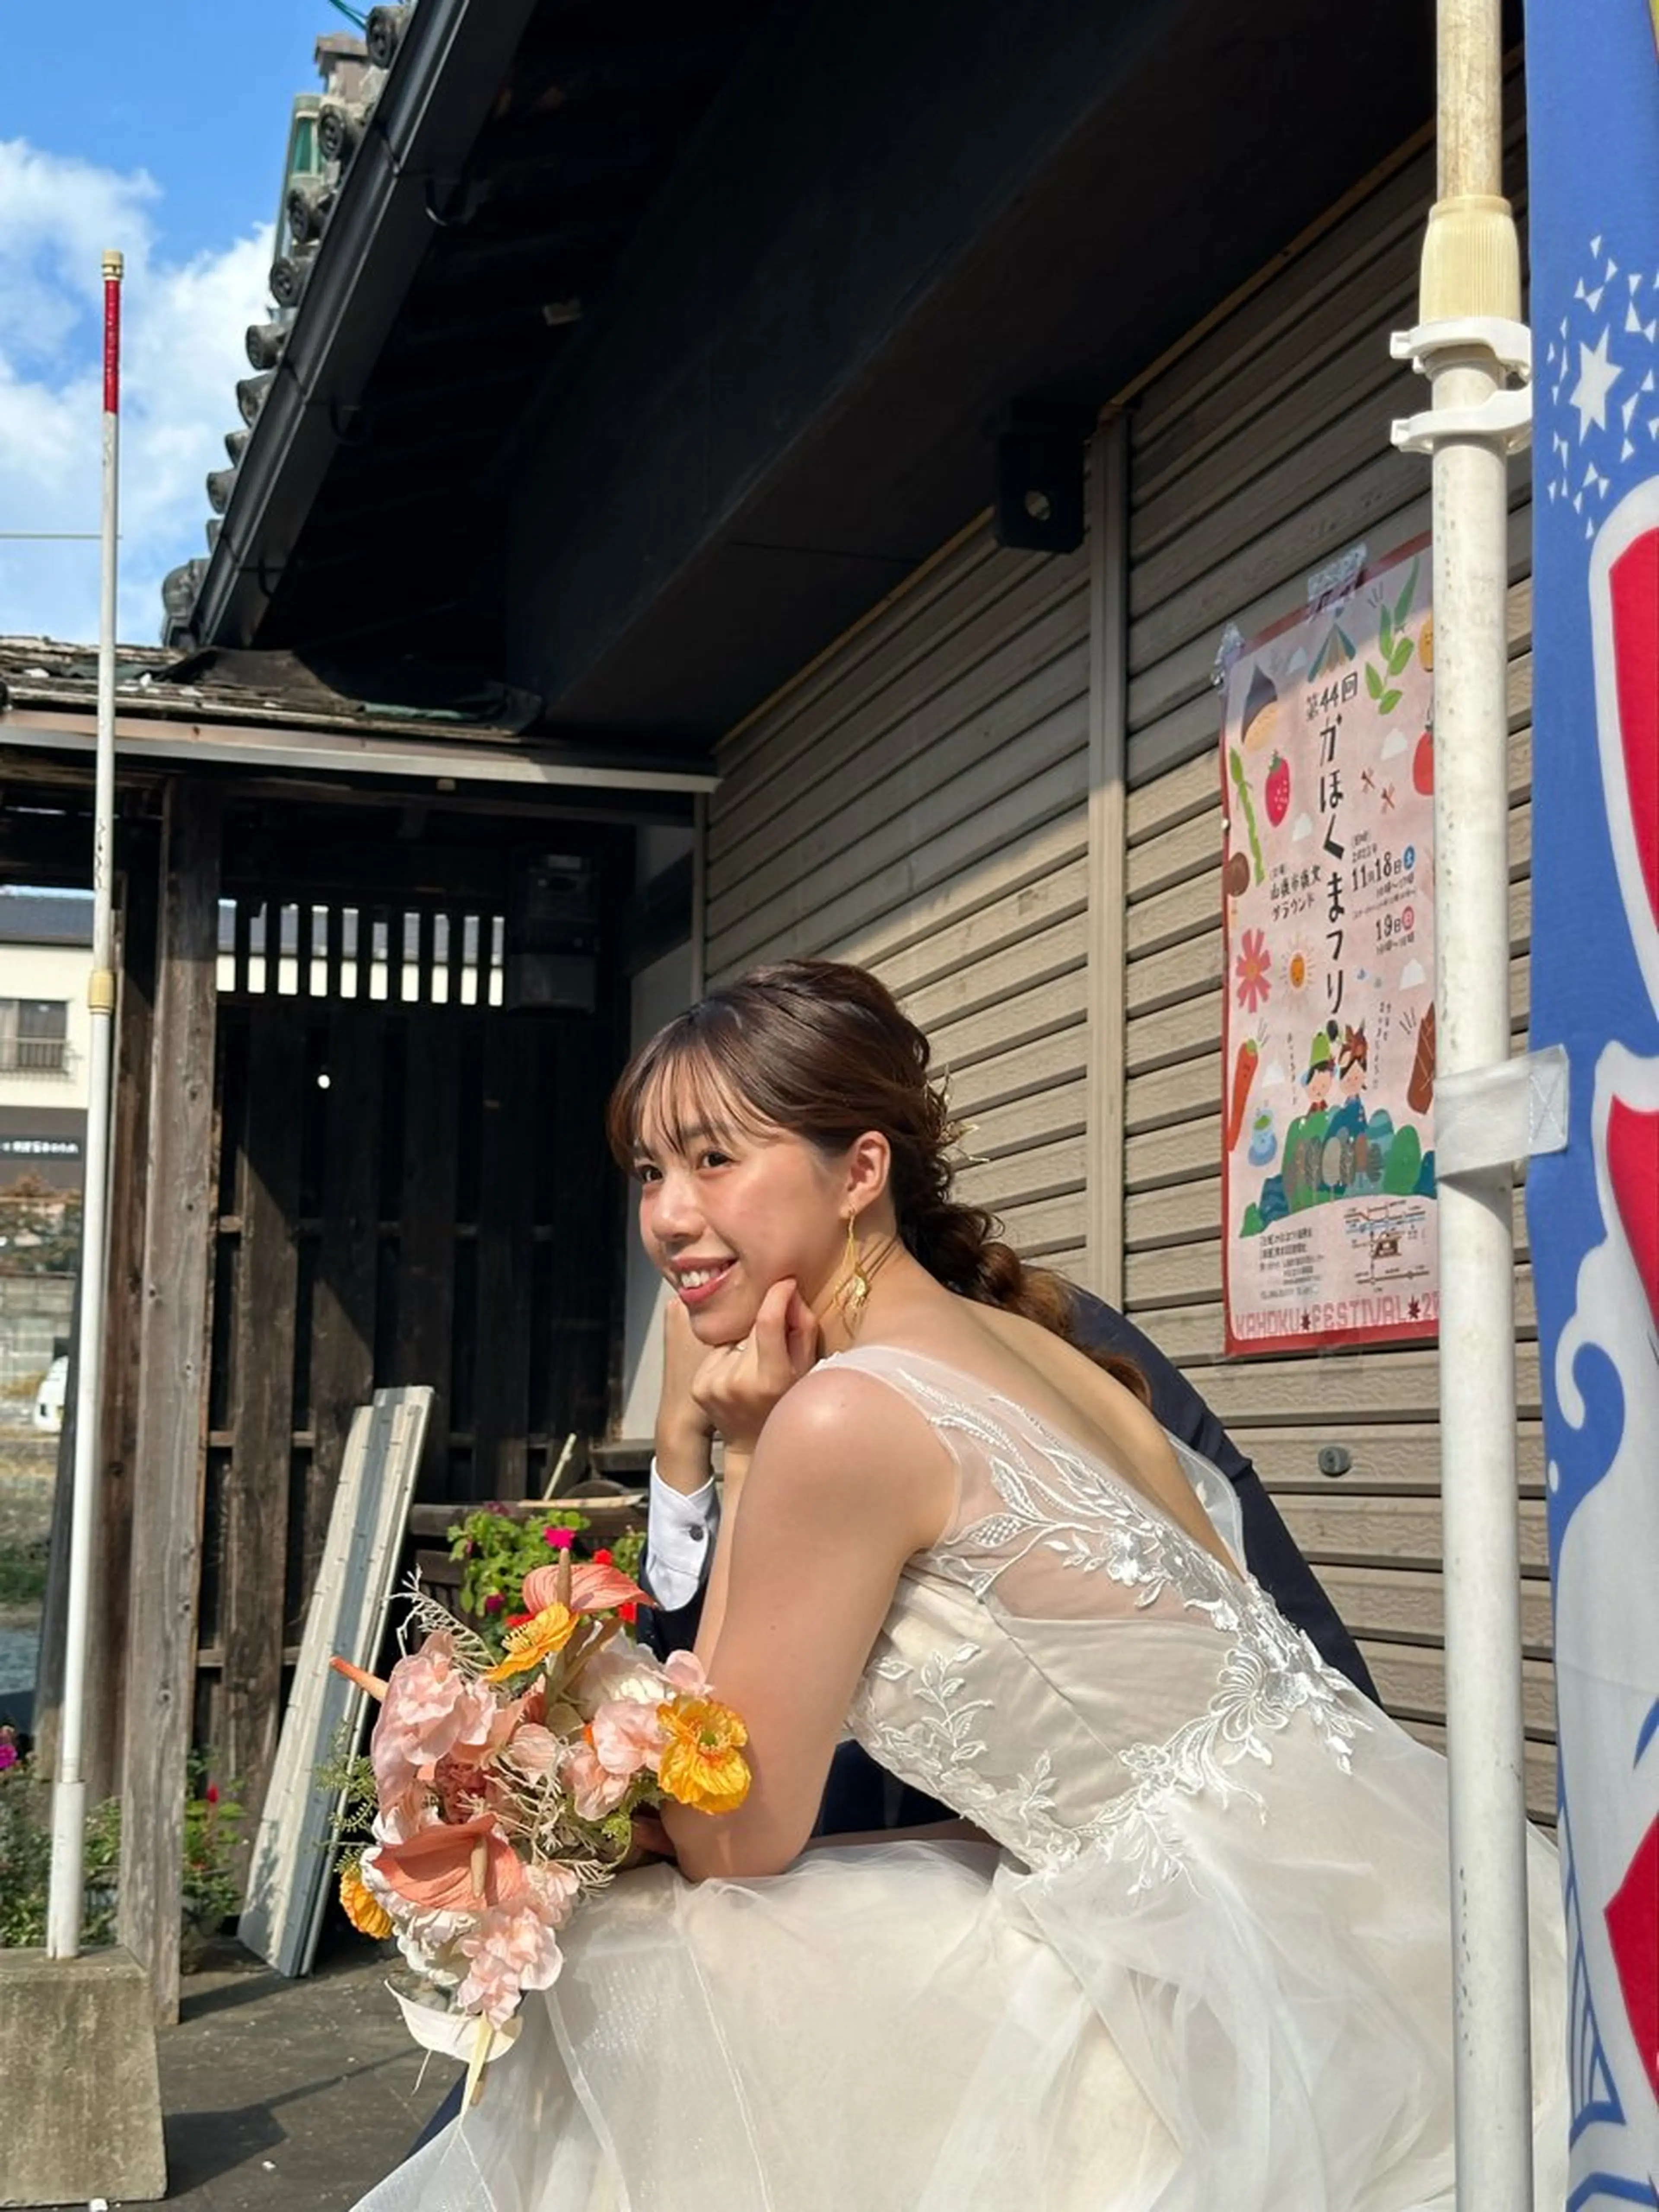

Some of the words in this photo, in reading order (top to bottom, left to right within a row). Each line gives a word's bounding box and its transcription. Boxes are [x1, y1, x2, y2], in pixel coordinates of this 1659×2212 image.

[1306, 671, 1357, 721] 第44回
[1273, 892, 1315, 922] グラウンド
[1376, 914, 1402, 941] 19日
[1311, 1295, 1406, 1332] FESTIVAL
